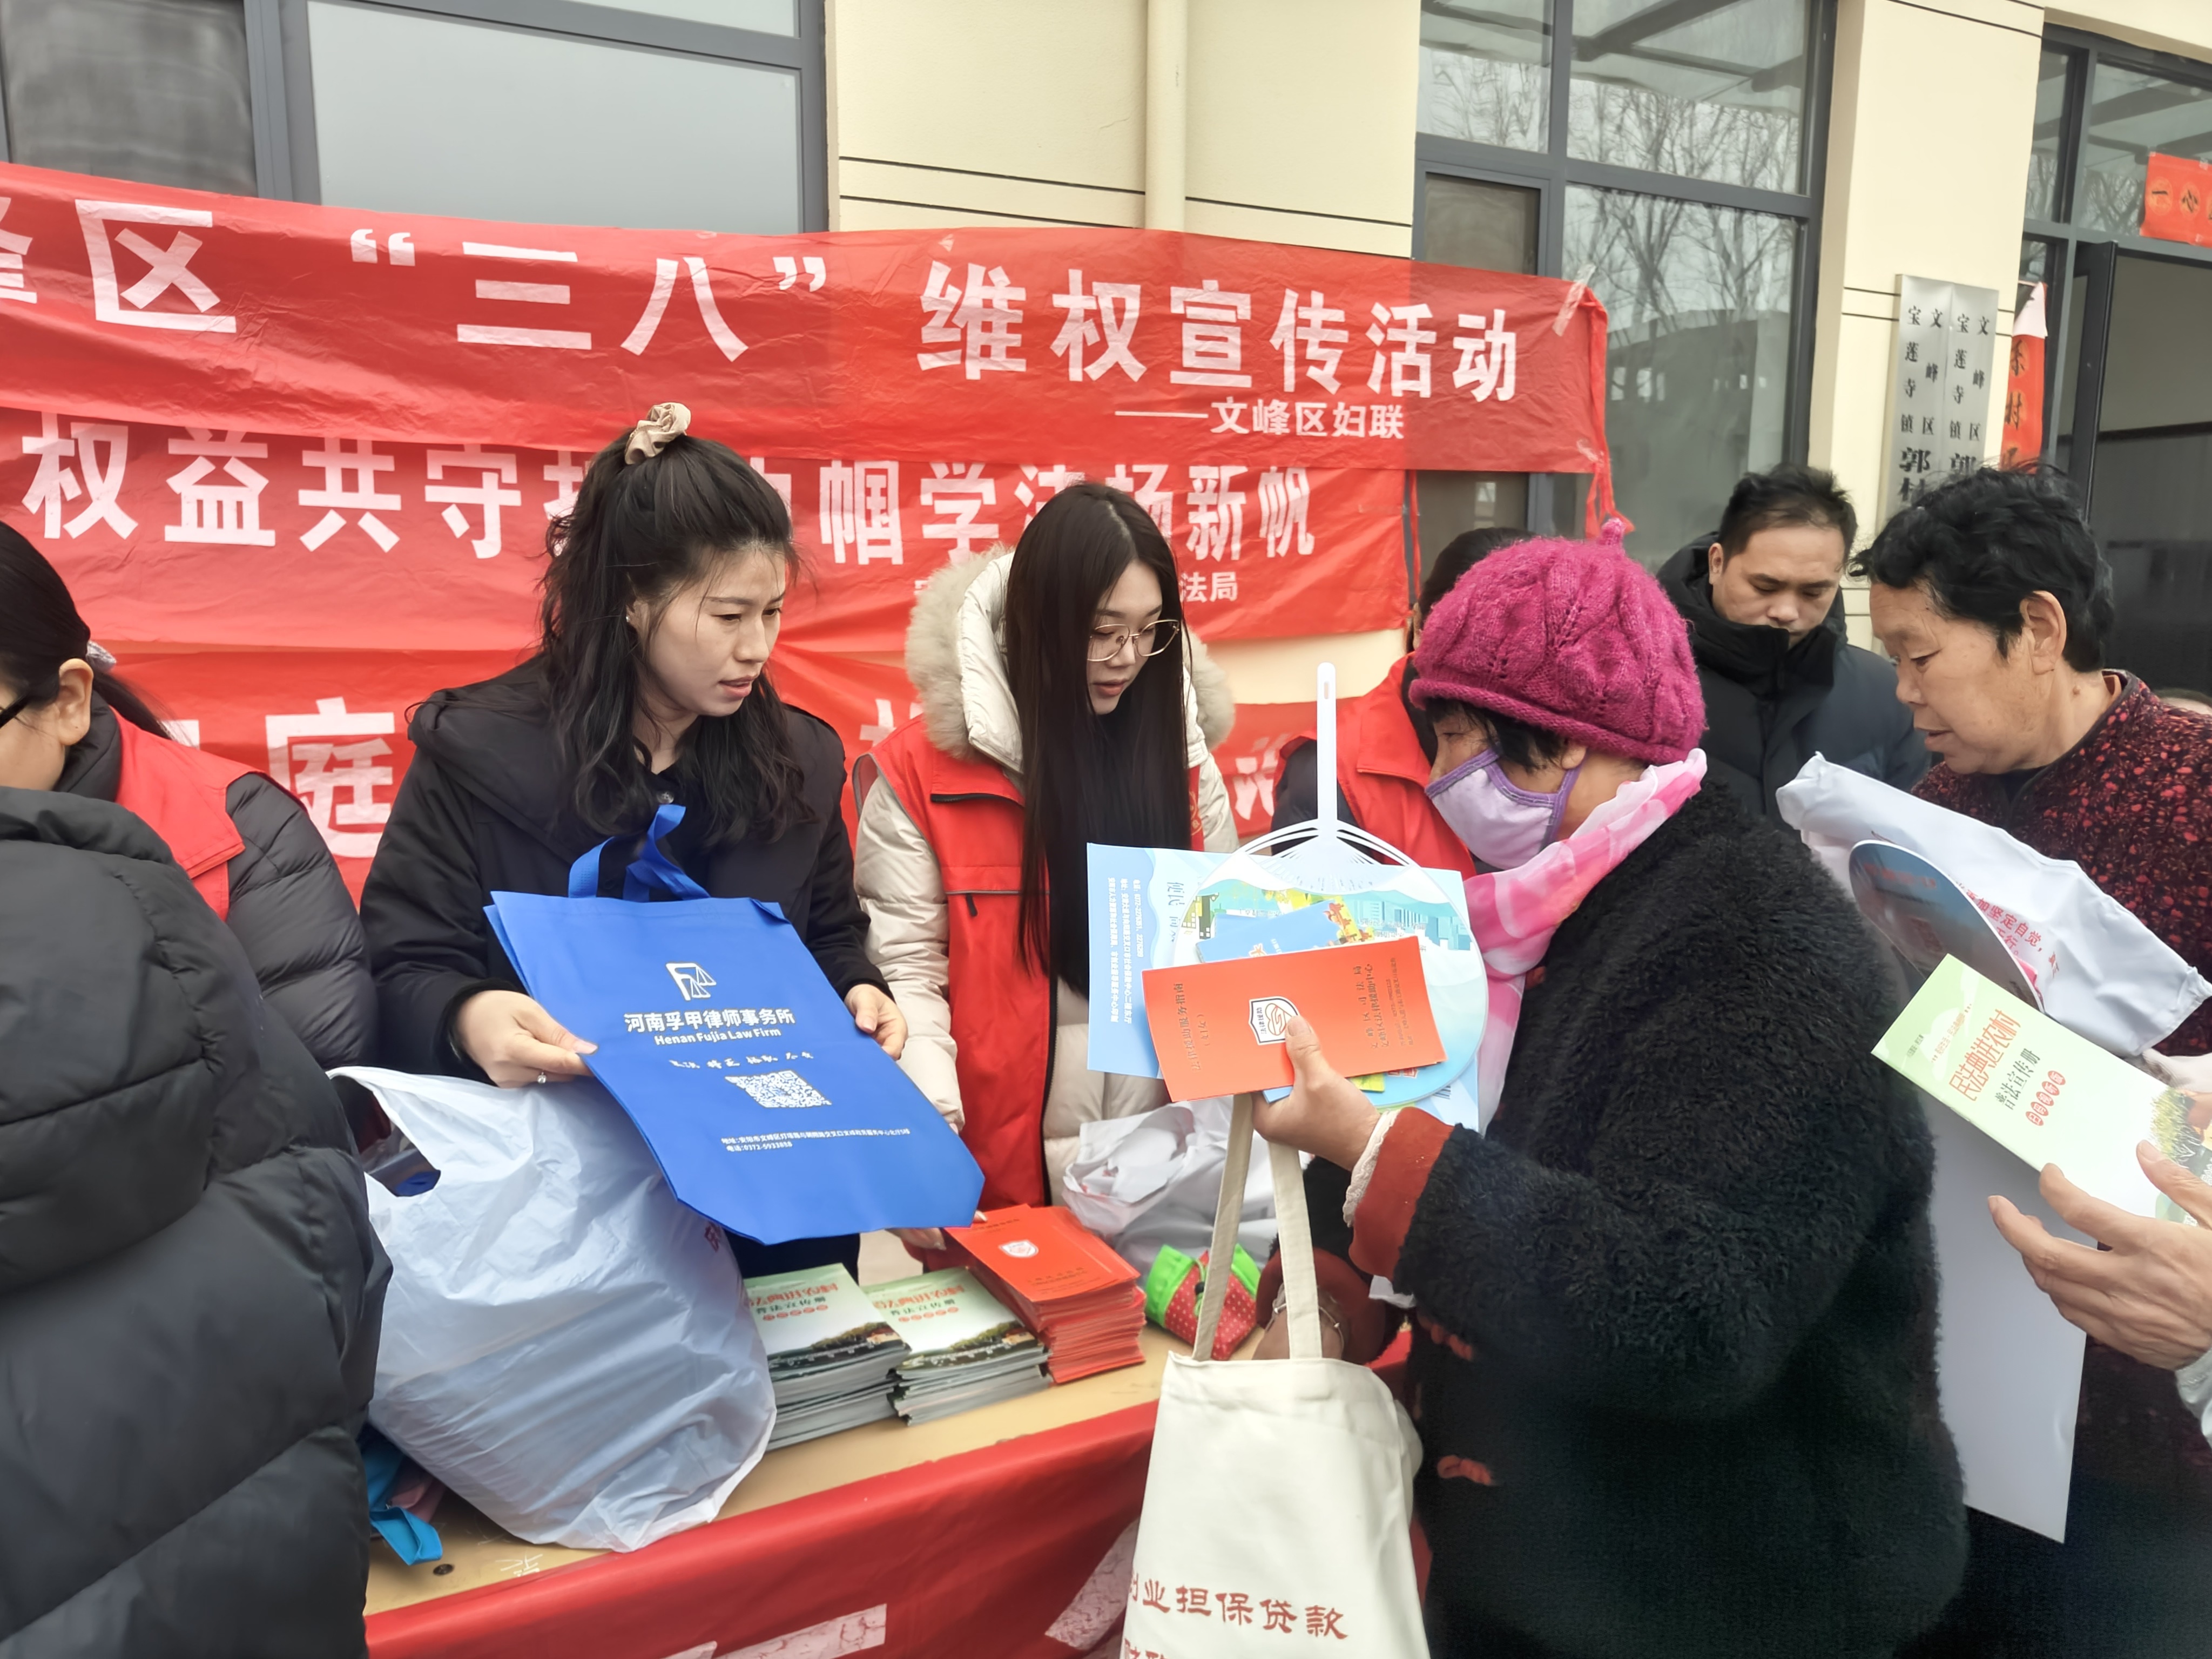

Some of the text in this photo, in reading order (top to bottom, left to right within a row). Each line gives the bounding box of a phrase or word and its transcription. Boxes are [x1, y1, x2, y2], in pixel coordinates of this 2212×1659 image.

[1900, 305, 1921, 434] 宝莲寺镇
[1921, 308, 1944, 436] 文峰区
[1949, 313, 1970, 442] 宝莲寺镇
[1968, 315, 1990, 442] 文峰区
[624, 1008, 795, 1033] 河南孚甲律师事务所
[654, 1027, 781, 1046] Henan Fujia Law Firm
[1948, 1008, 2021, 1101] 民法典进农村
[1994, 1048, 2041, 1110] 普法宣传册
